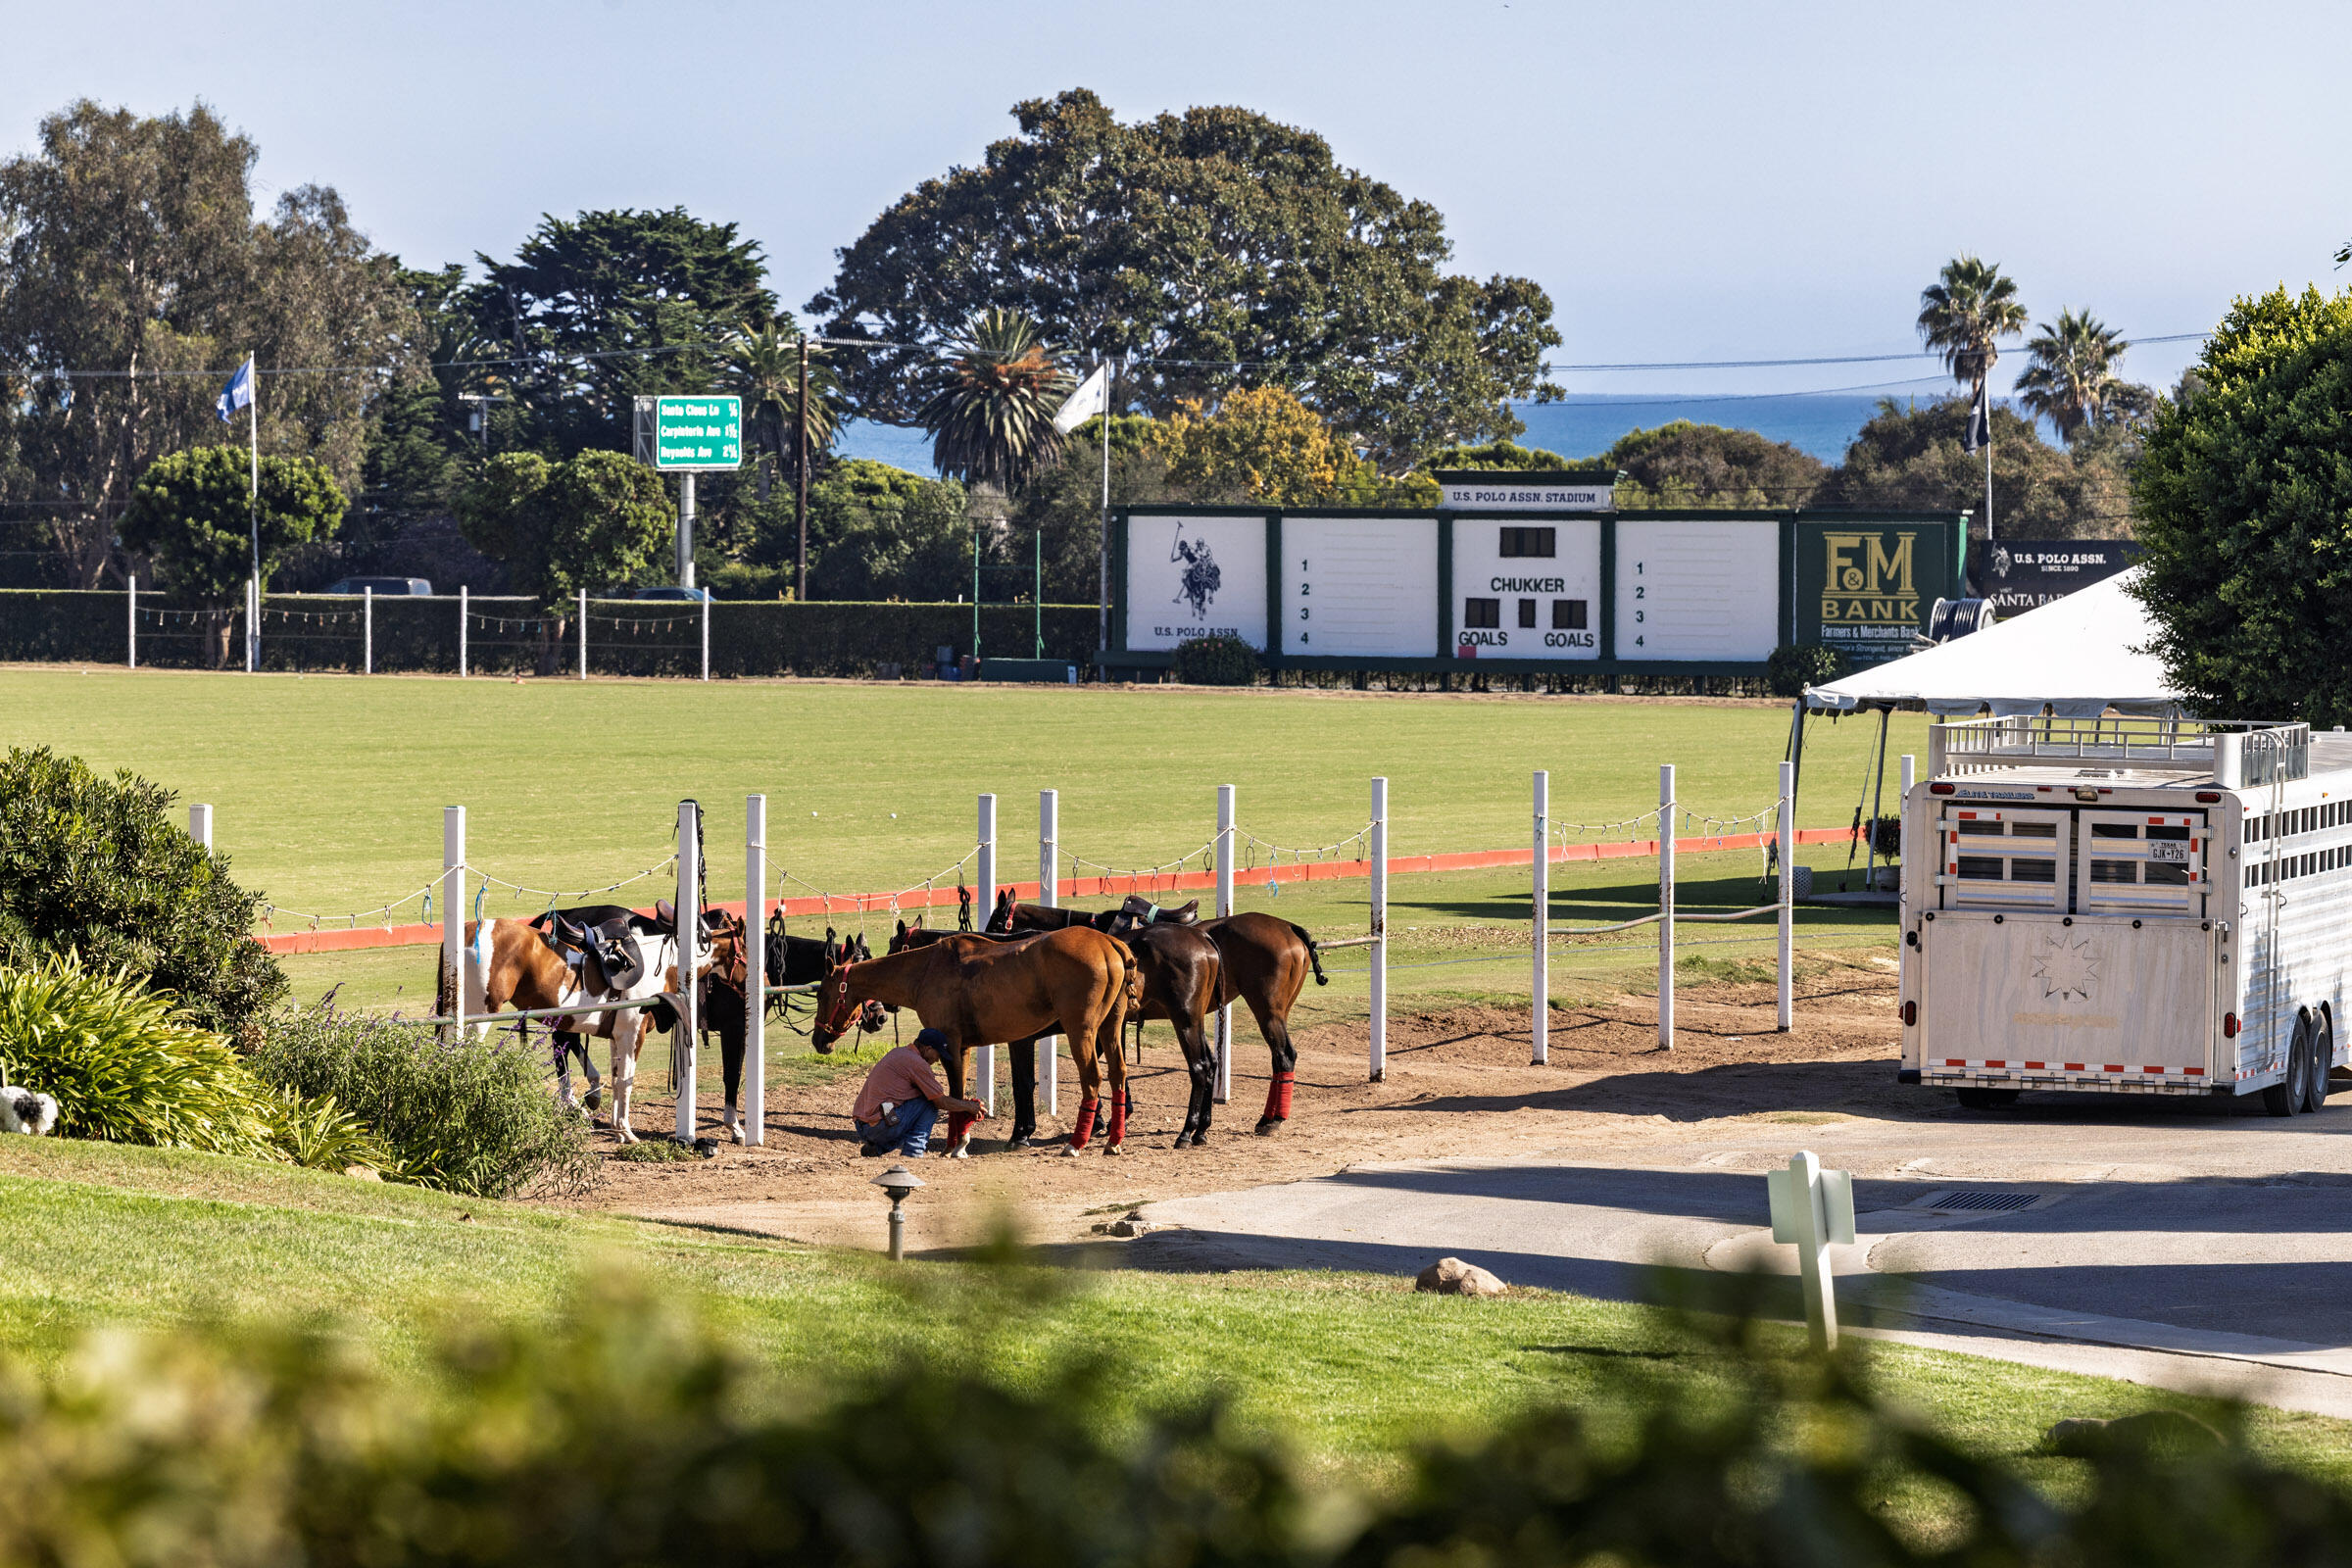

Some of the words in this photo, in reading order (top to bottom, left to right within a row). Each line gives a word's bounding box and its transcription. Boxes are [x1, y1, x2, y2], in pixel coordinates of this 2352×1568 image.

[706, 425, 721, 437] Ave
[697, 446, 712, 458] Ave
[1452, 491, 1472, 502] U.S.
[1475, 492, 1506, 503] POLO
[1508, 492, 1544, 503] ASSN.
[1545, 492, 1596, 504] STADIUM
[1301, 559, 1308, 571] 1
[1822, 532, 1918, 595] F&M
[2014, 553, 2034, 564] U.S.
[2037, 554, 2069, 564] POLO
[2071, 554, 2107, 565] ASSN.
[1636, 562, 1643, 574] 1
[1300, 583, 1310, 596] 2
[1490, 576, 1566, 593] CHUKKER
[1635, 586, 1645, 599] 2
[1989, 593, 2034, 606] SANTA
[1299, 608, 1309, 620] 3
[1821, 600, 1920, 619] BANK
[1635, 610, 1645, 623] 3
[1153, 626, 1173, 637] U.S.
[1176, 627, 1205, 637] POLO
[1821, 625, 1851, 638] Farmers
[1852, 626, 1859, 639] &
[1861, 625, 1899, 639] Merchants
[1299, 632, 1309, 645] 4
[1457, 631, 1508, 647] GOALS
[1544, 632, 1594, 648] GOALS
[1635, 635, 1644, 648] 4
